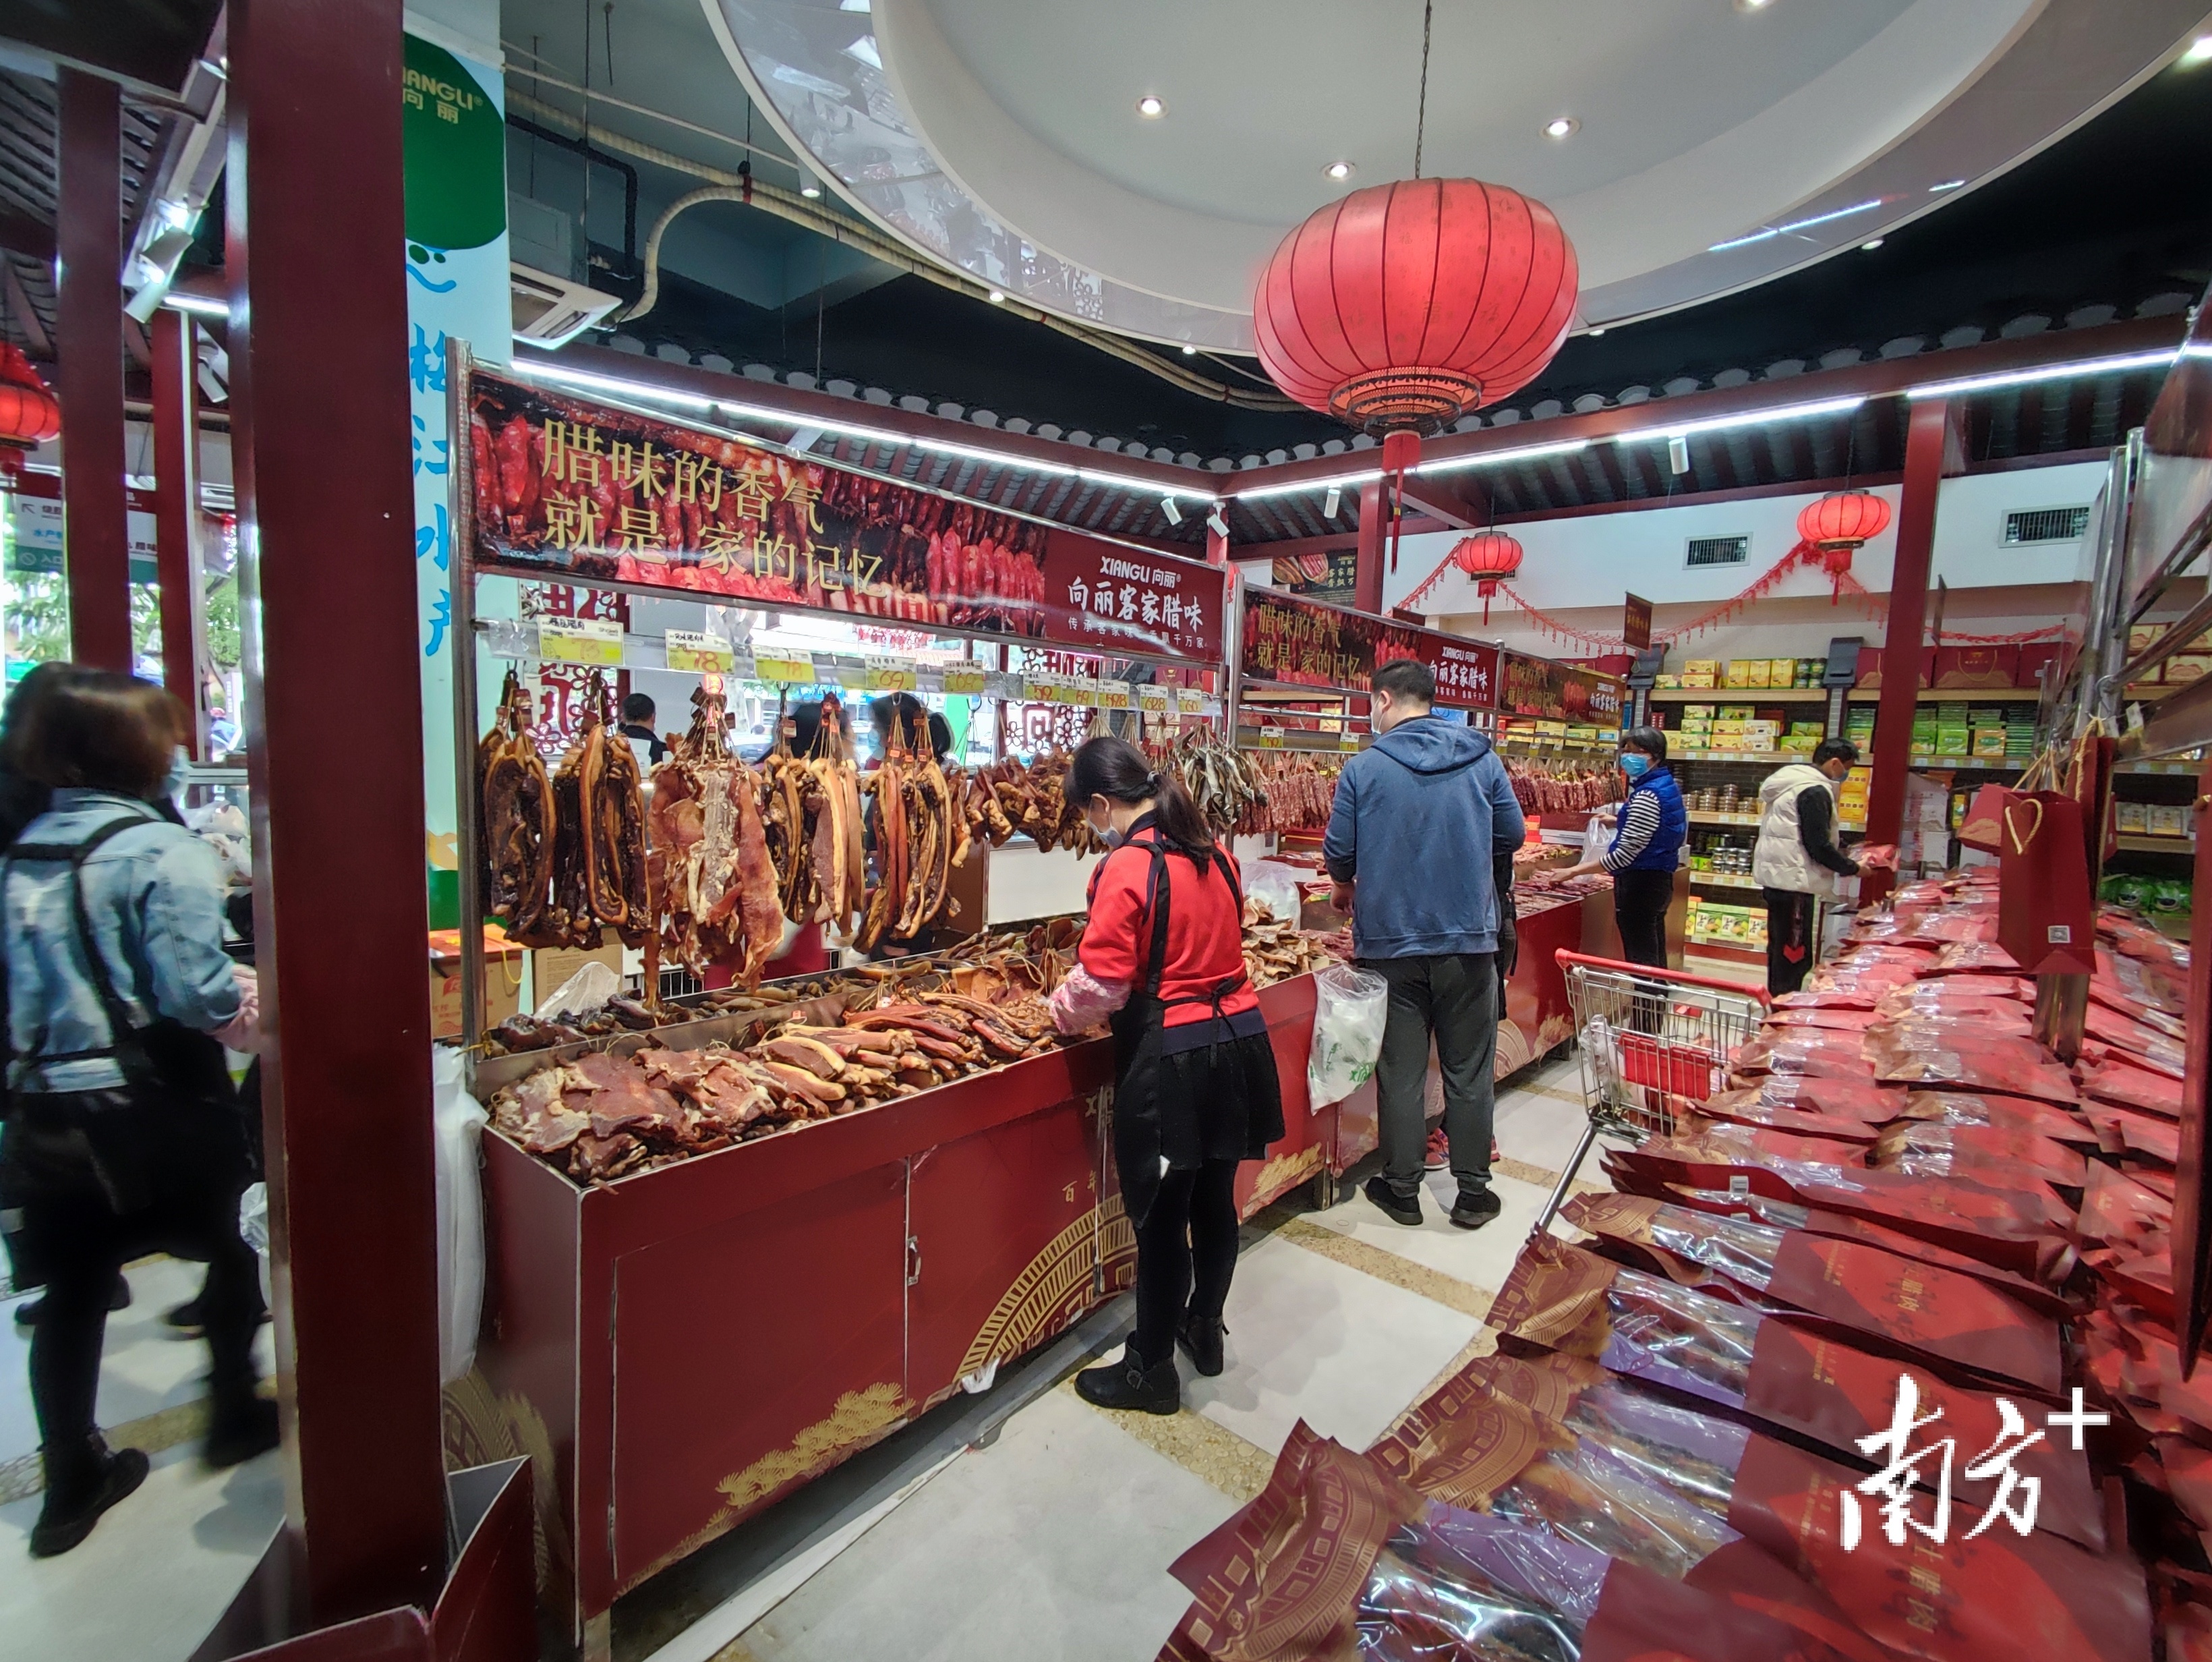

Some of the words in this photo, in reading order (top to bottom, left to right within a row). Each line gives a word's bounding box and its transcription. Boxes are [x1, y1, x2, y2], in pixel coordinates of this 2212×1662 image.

[542, 418, 824, 534] 腊味的香气
[1100, 556, 1151, 583] XIANGLI
[1152, 568, 1177, 589] 向丽
[1068, 576, 1203, 633] 向丽客家腊味
[1258, 604, 1341, 648] 腊味的香气
[879, 670, 904, 690] 69
